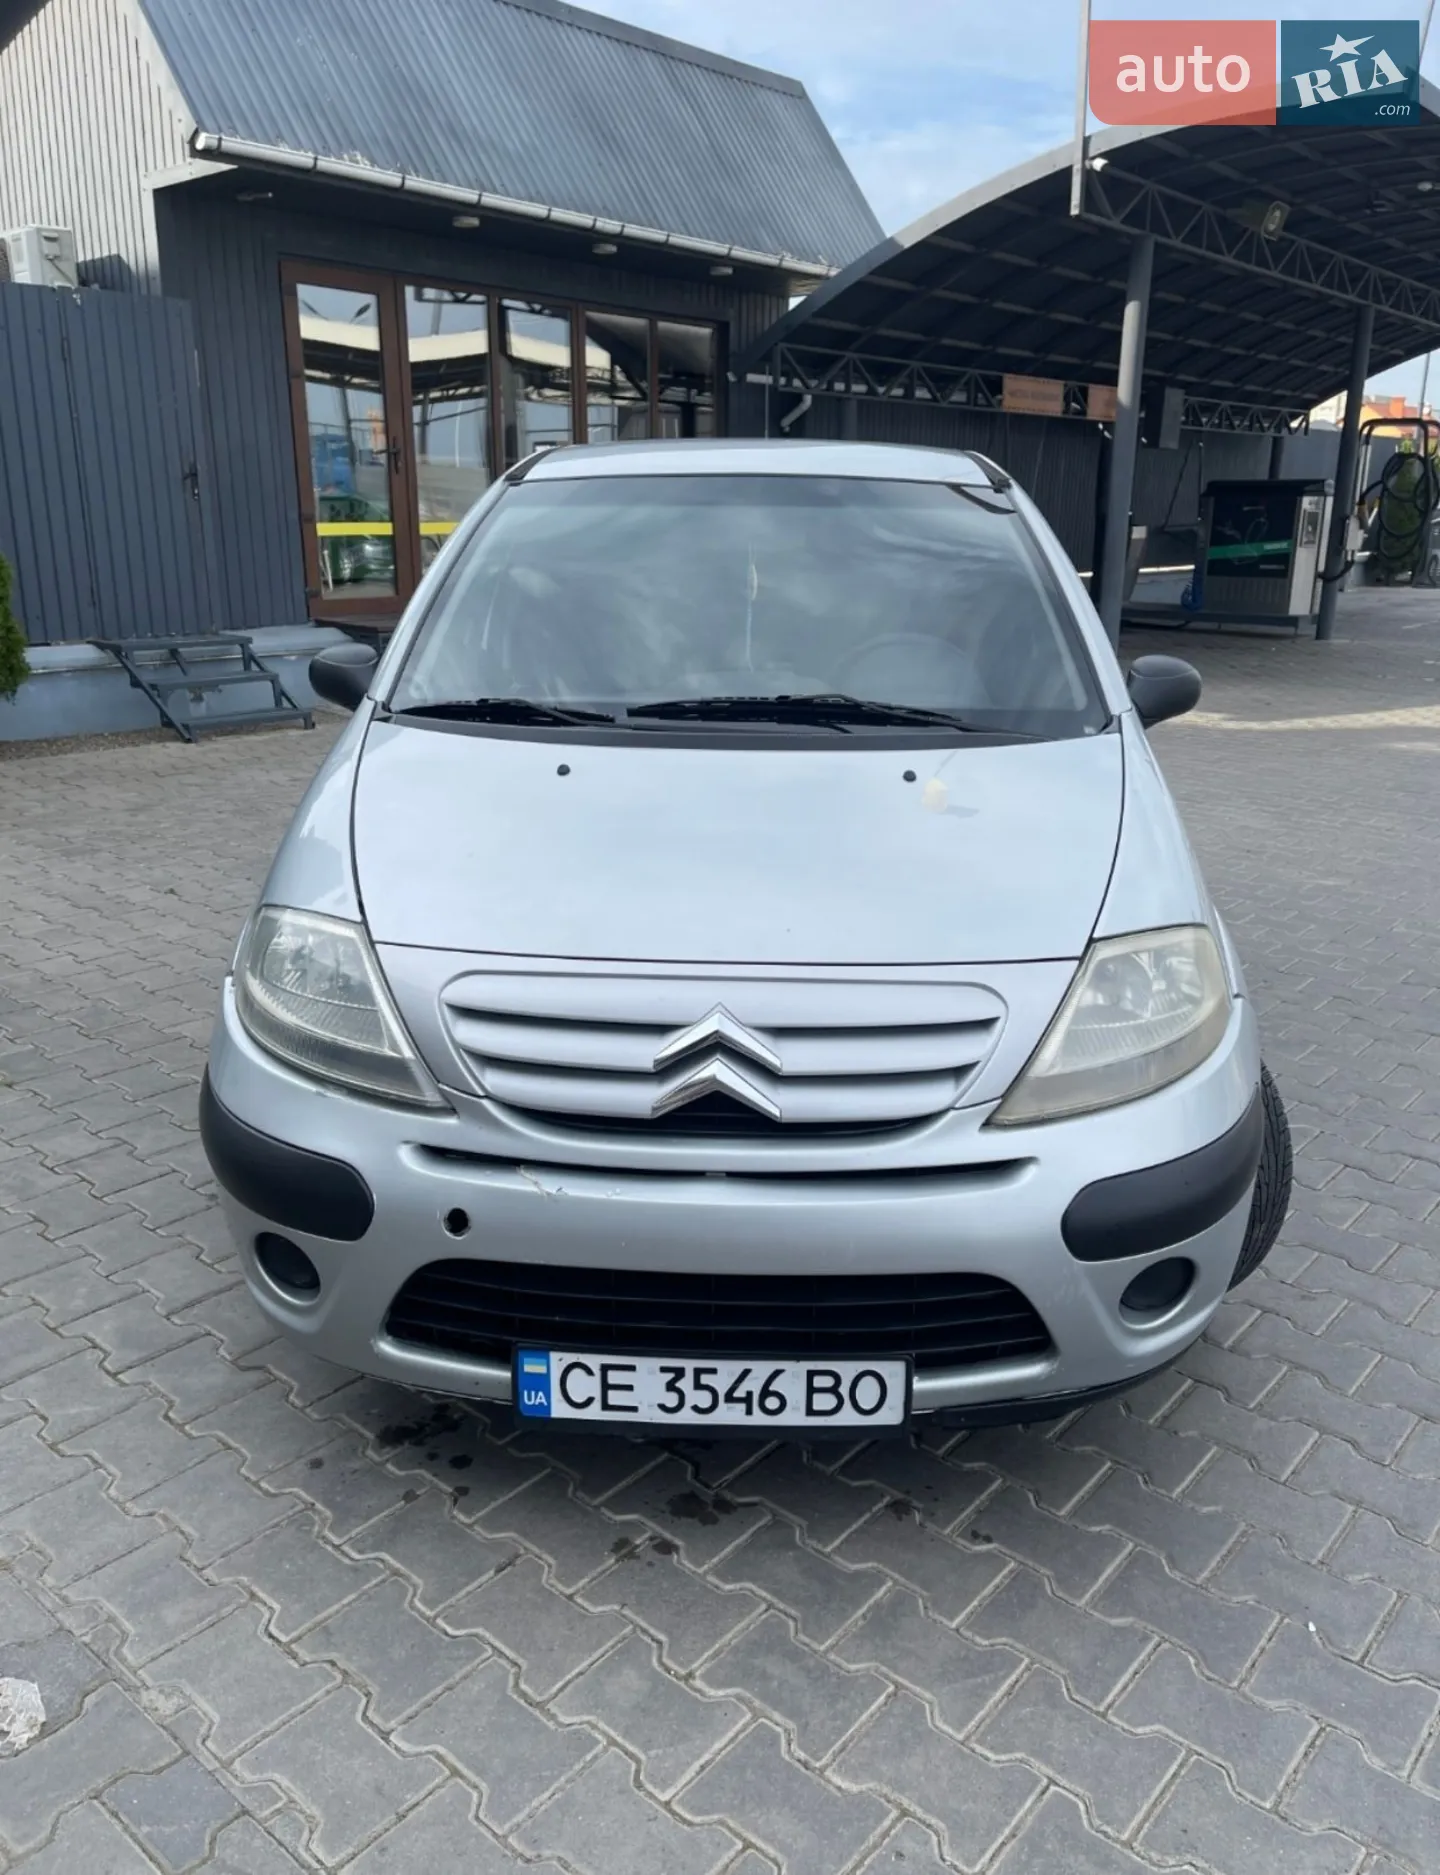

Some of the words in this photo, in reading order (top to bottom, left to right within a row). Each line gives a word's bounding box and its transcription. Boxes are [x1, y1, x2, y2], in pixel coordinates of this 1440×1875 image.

[523, 1390, 547, 1406] UA
[559, 1361, 639, 1413] CE
[657, 1366, 787, 1416] 3546
[805, 1369, 888, 1417] BO
